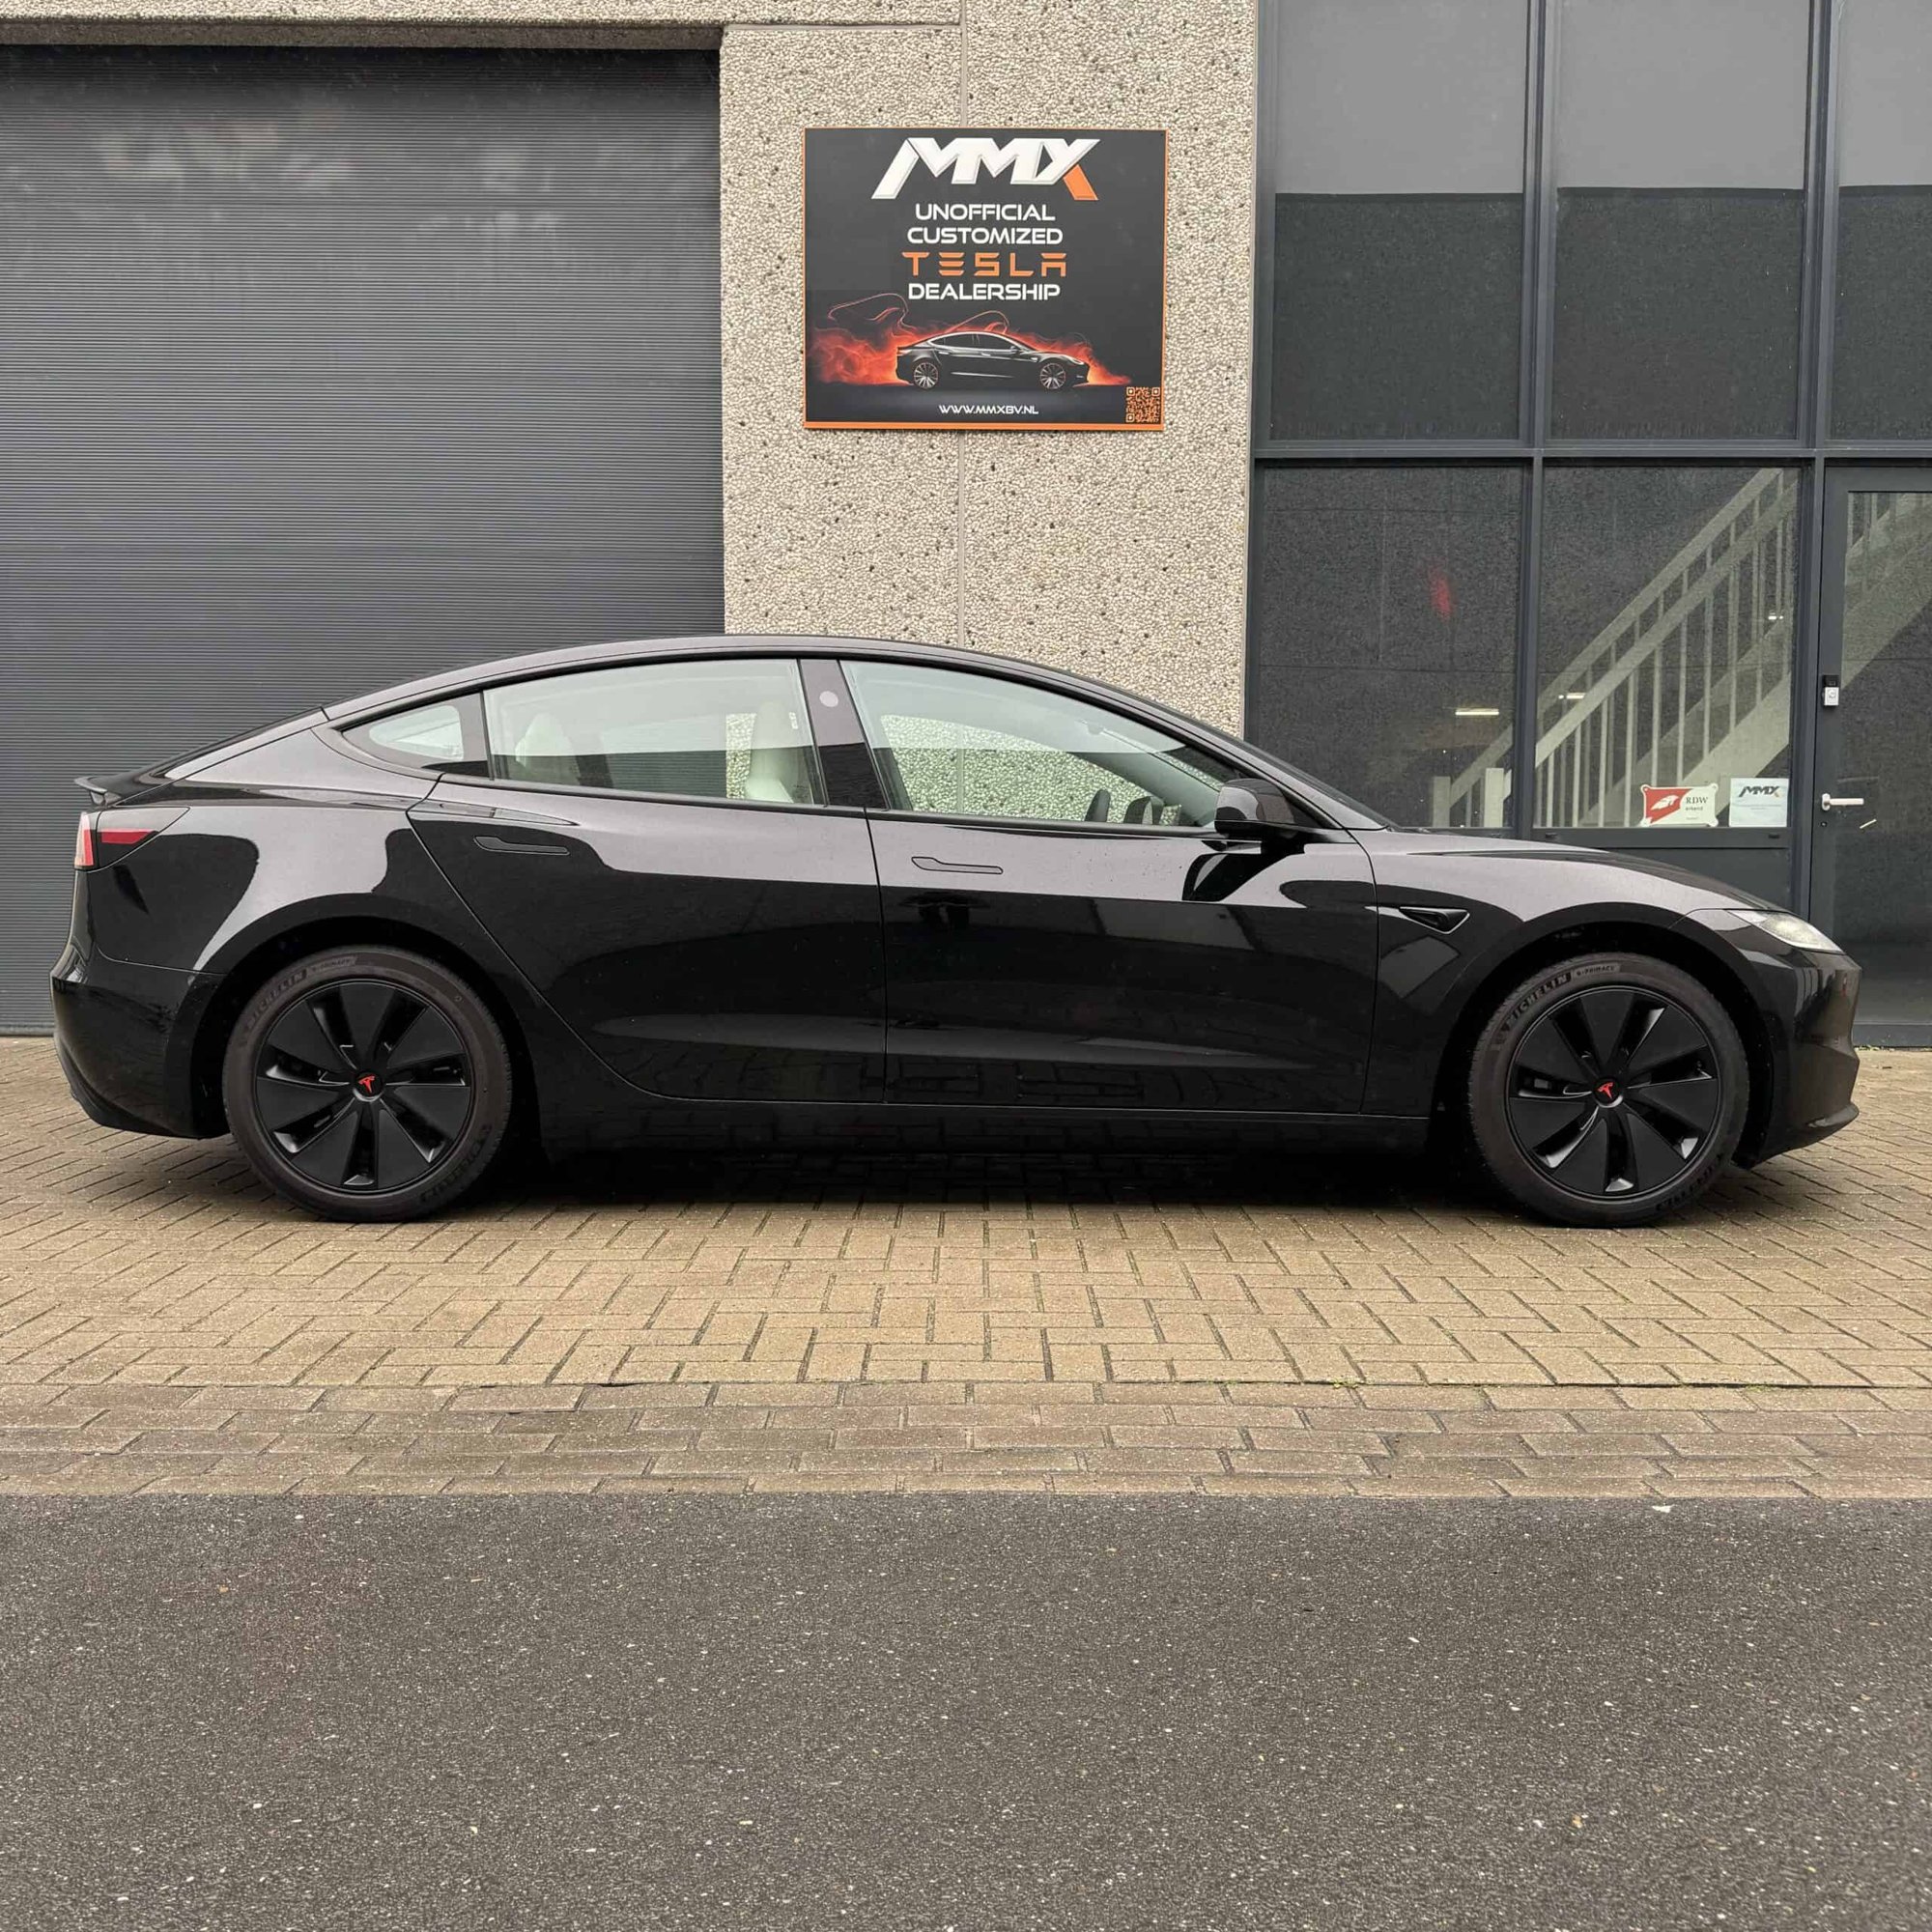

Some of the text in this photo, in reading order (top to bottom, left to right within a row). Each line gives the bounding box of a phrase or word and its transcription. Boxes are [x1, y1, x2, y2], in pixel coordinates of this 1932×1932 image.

[871, 137, 1101, 200] MMX
[916, 203, 1056, 221] UNOFFICIAL
[907, 227, 1064, 244] CUSTOMIZED
[901, 251, 1067, 277] TESLA
[908, 283, 1061, 300] DEALERSHIP
[938, 404, 1039, 415] WWW.MMXBV.NL
[1739, 785, 1779, 798] MMX
[1686, 796, 1709, 805] RDW
[1505, 972, 1571, 1027] MICHELIN
